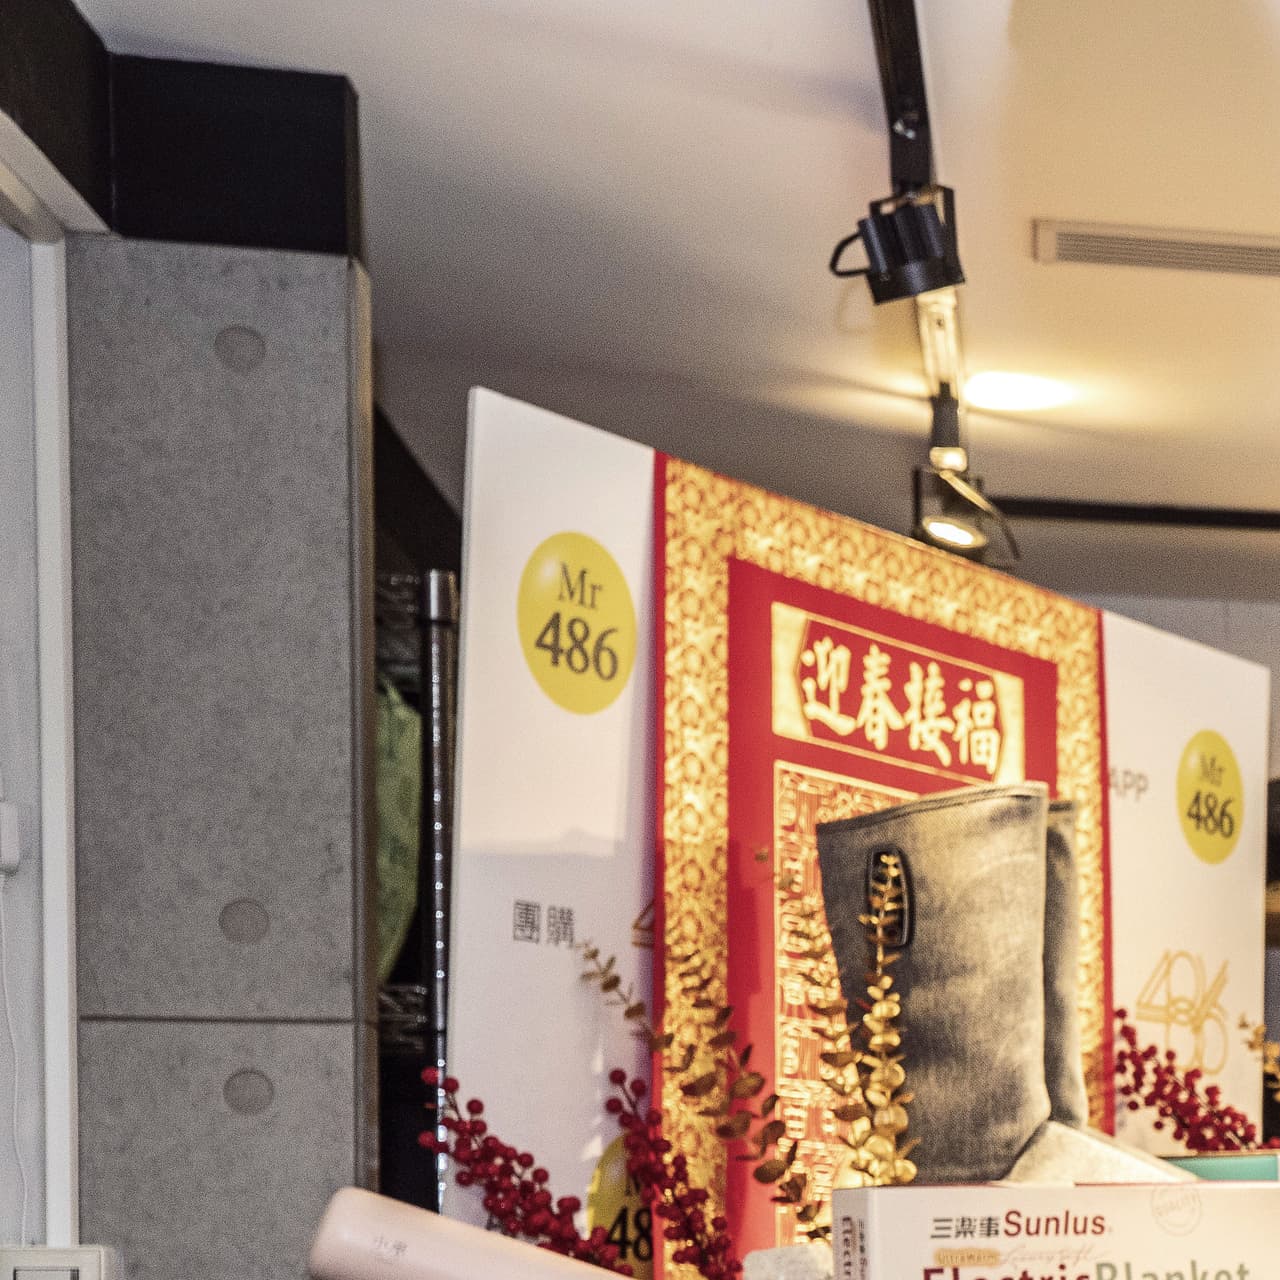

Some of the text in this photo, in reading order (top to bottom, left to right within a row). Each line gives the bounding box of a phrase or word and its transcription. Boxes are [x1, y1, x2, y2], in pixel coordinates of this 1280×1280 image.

[558, 562, 602, 609] Mr
[535, 610, 618, 681] 486
[800, 636, 1000, 775] 迎春接福
[1201, 752, 1226, 787] Mr
[1186, 790, 1235, 839] 486
[513, 899, 575, 950] 團購
[607, 1205, 654, 1262] 48
[1003, 1209, 1107, 1238] Sunlus
